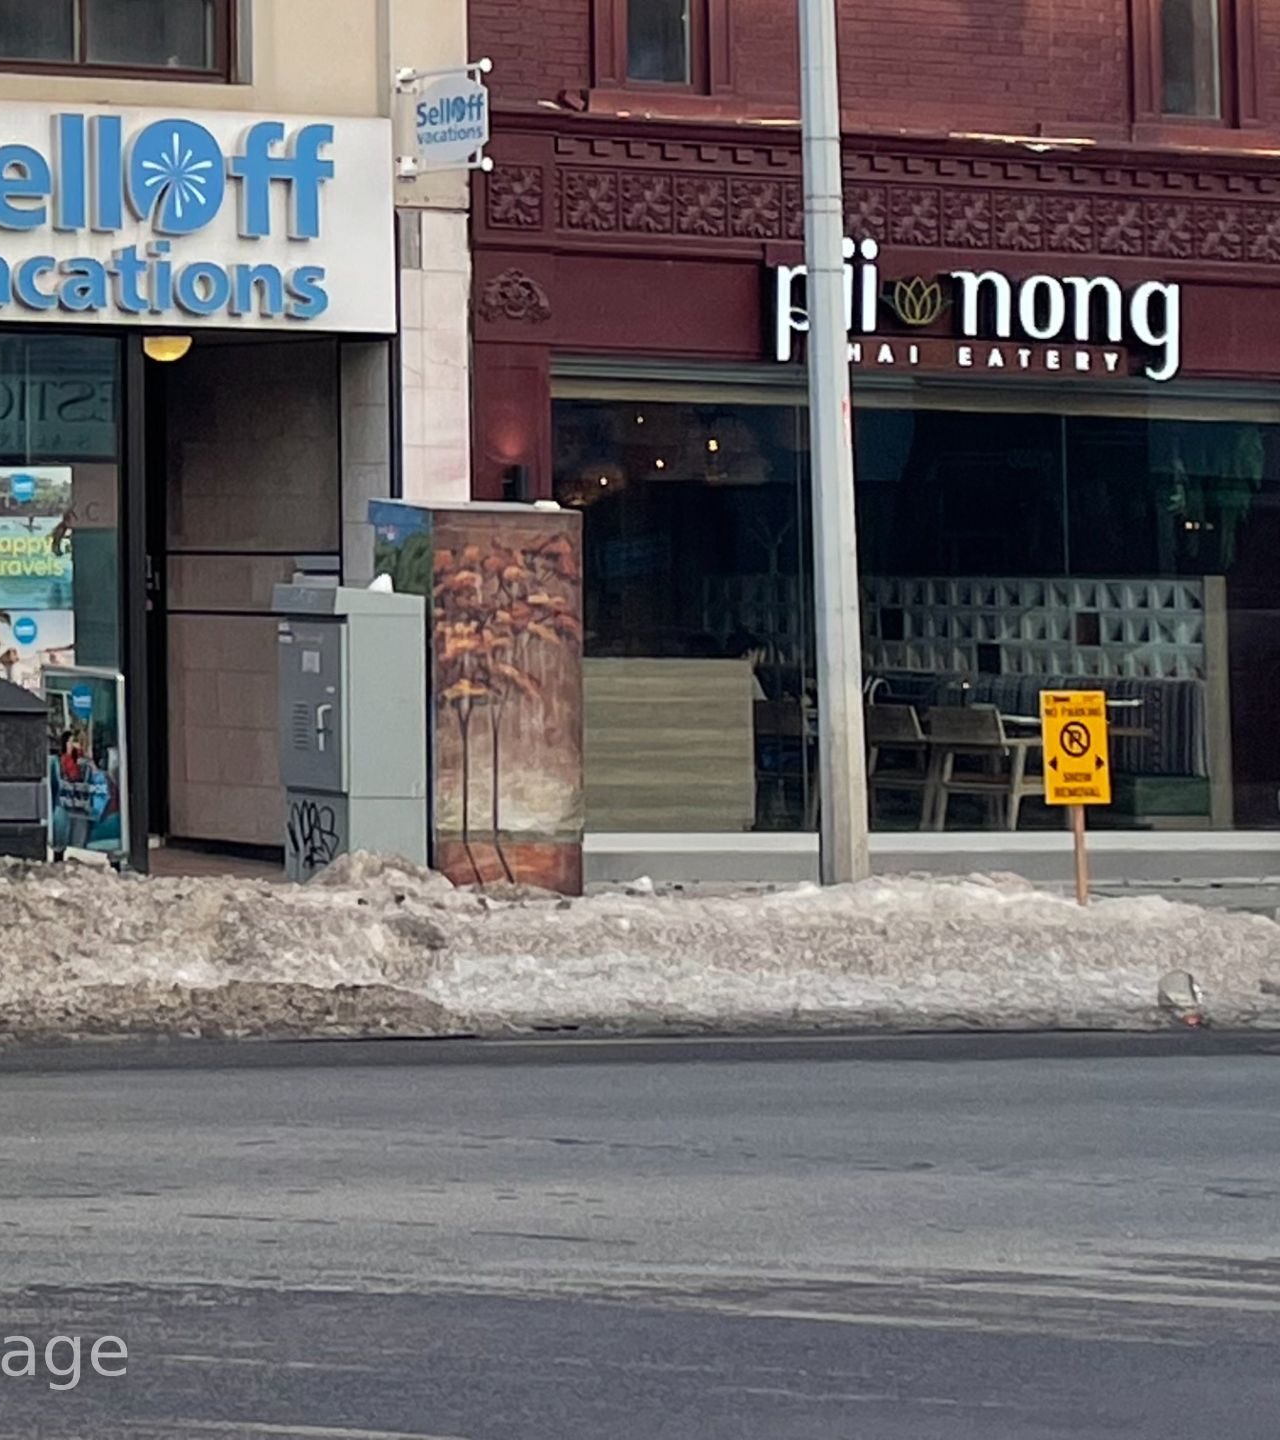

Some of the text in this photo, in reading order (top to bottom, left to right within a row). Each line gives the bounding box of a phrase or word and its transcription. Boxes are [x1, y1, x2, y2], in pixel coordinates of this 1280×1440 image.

[416, 93, 484, 128] SellOff
[417, 125, 483, 144] vacations
[950, 271, 1180, 382] nong
[847, 343, 1120, 372] HAI EATERY
